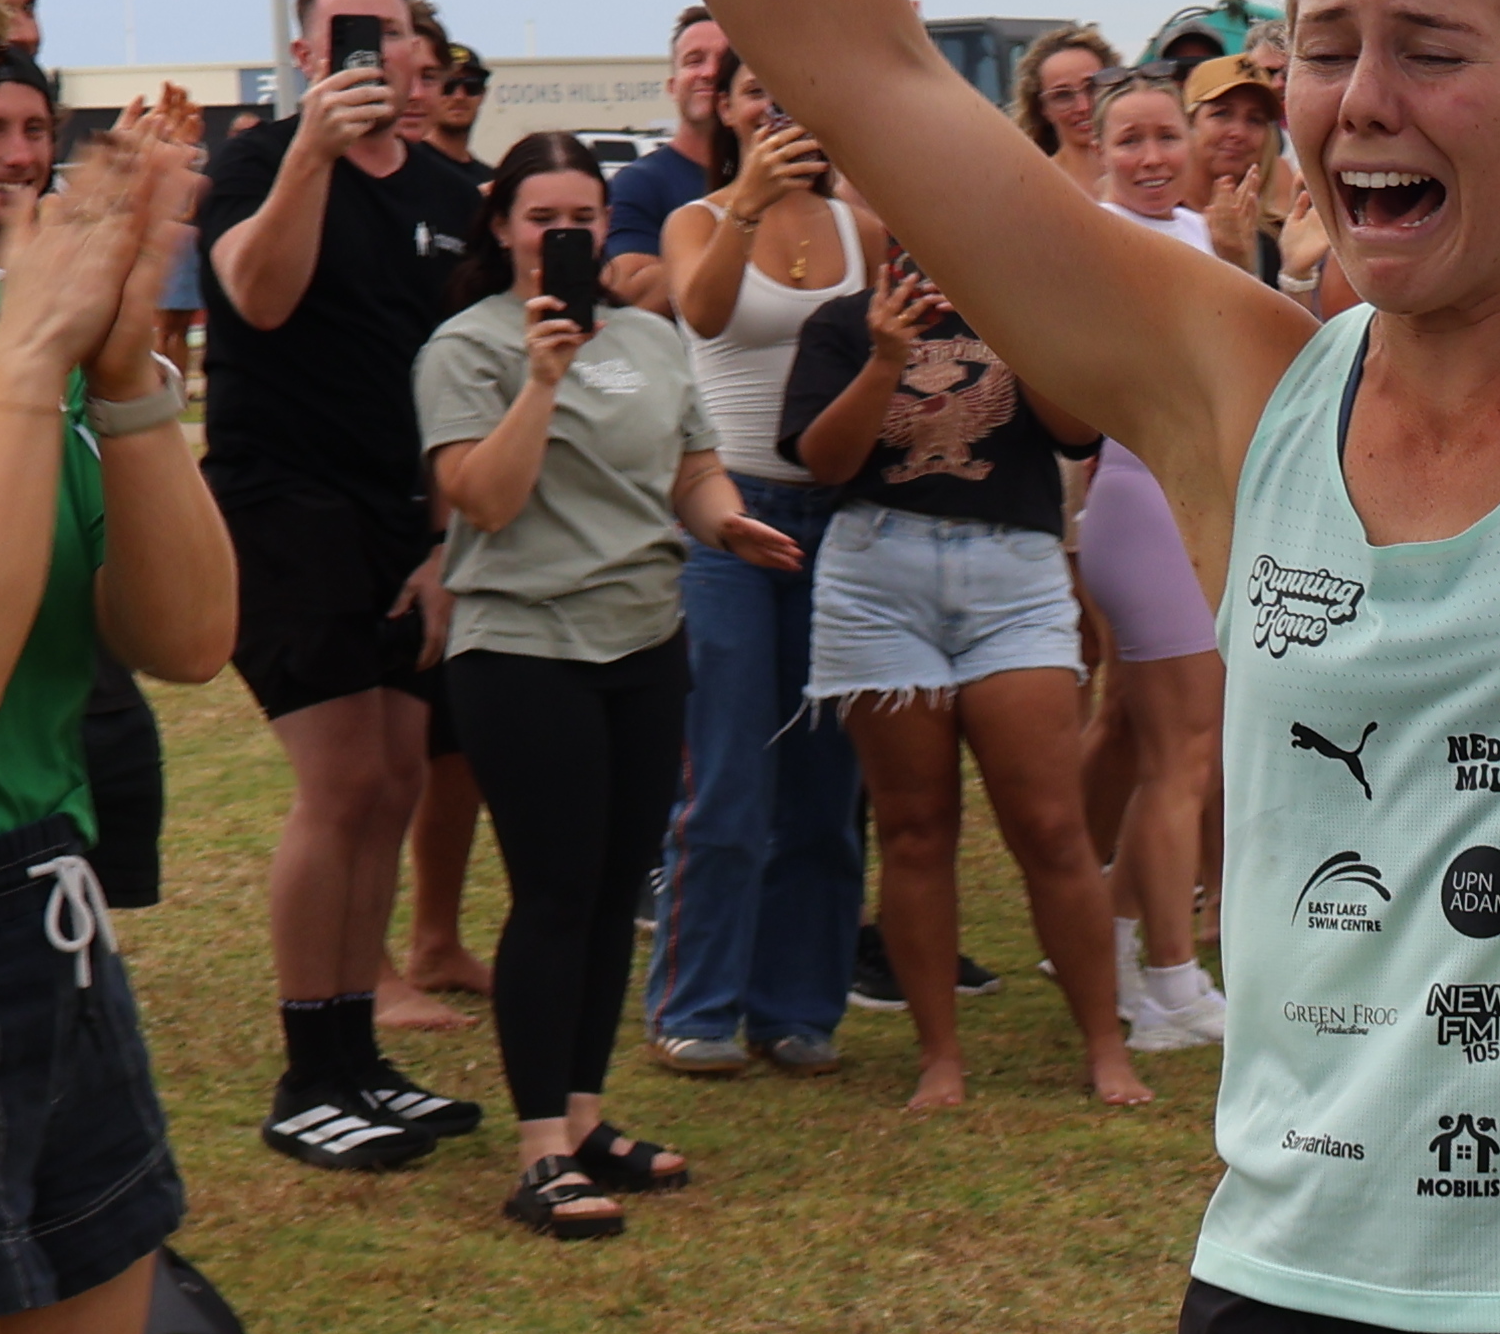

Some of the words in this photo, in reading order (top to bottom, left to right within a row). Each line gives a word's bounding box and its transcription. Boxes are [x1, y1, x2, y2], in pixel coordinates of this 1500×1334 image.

[567, 82, 609, 103] HILL
[1248, 554, 1365, 625] Running
[1254, 605, 1328, 659] Home
[1452, 870, 1493, 893] UPN
[1308, 901, 1335, 916] EAST
[1336, 903, 1368, 917] LAKES
[1308, 916, 1339, 930] SWIM
[1340, 919, 1383, 933] CENTRE
[1315, 1022, 1370, 1037] Productions
[1438, 1015, 1499, 1045] FM
